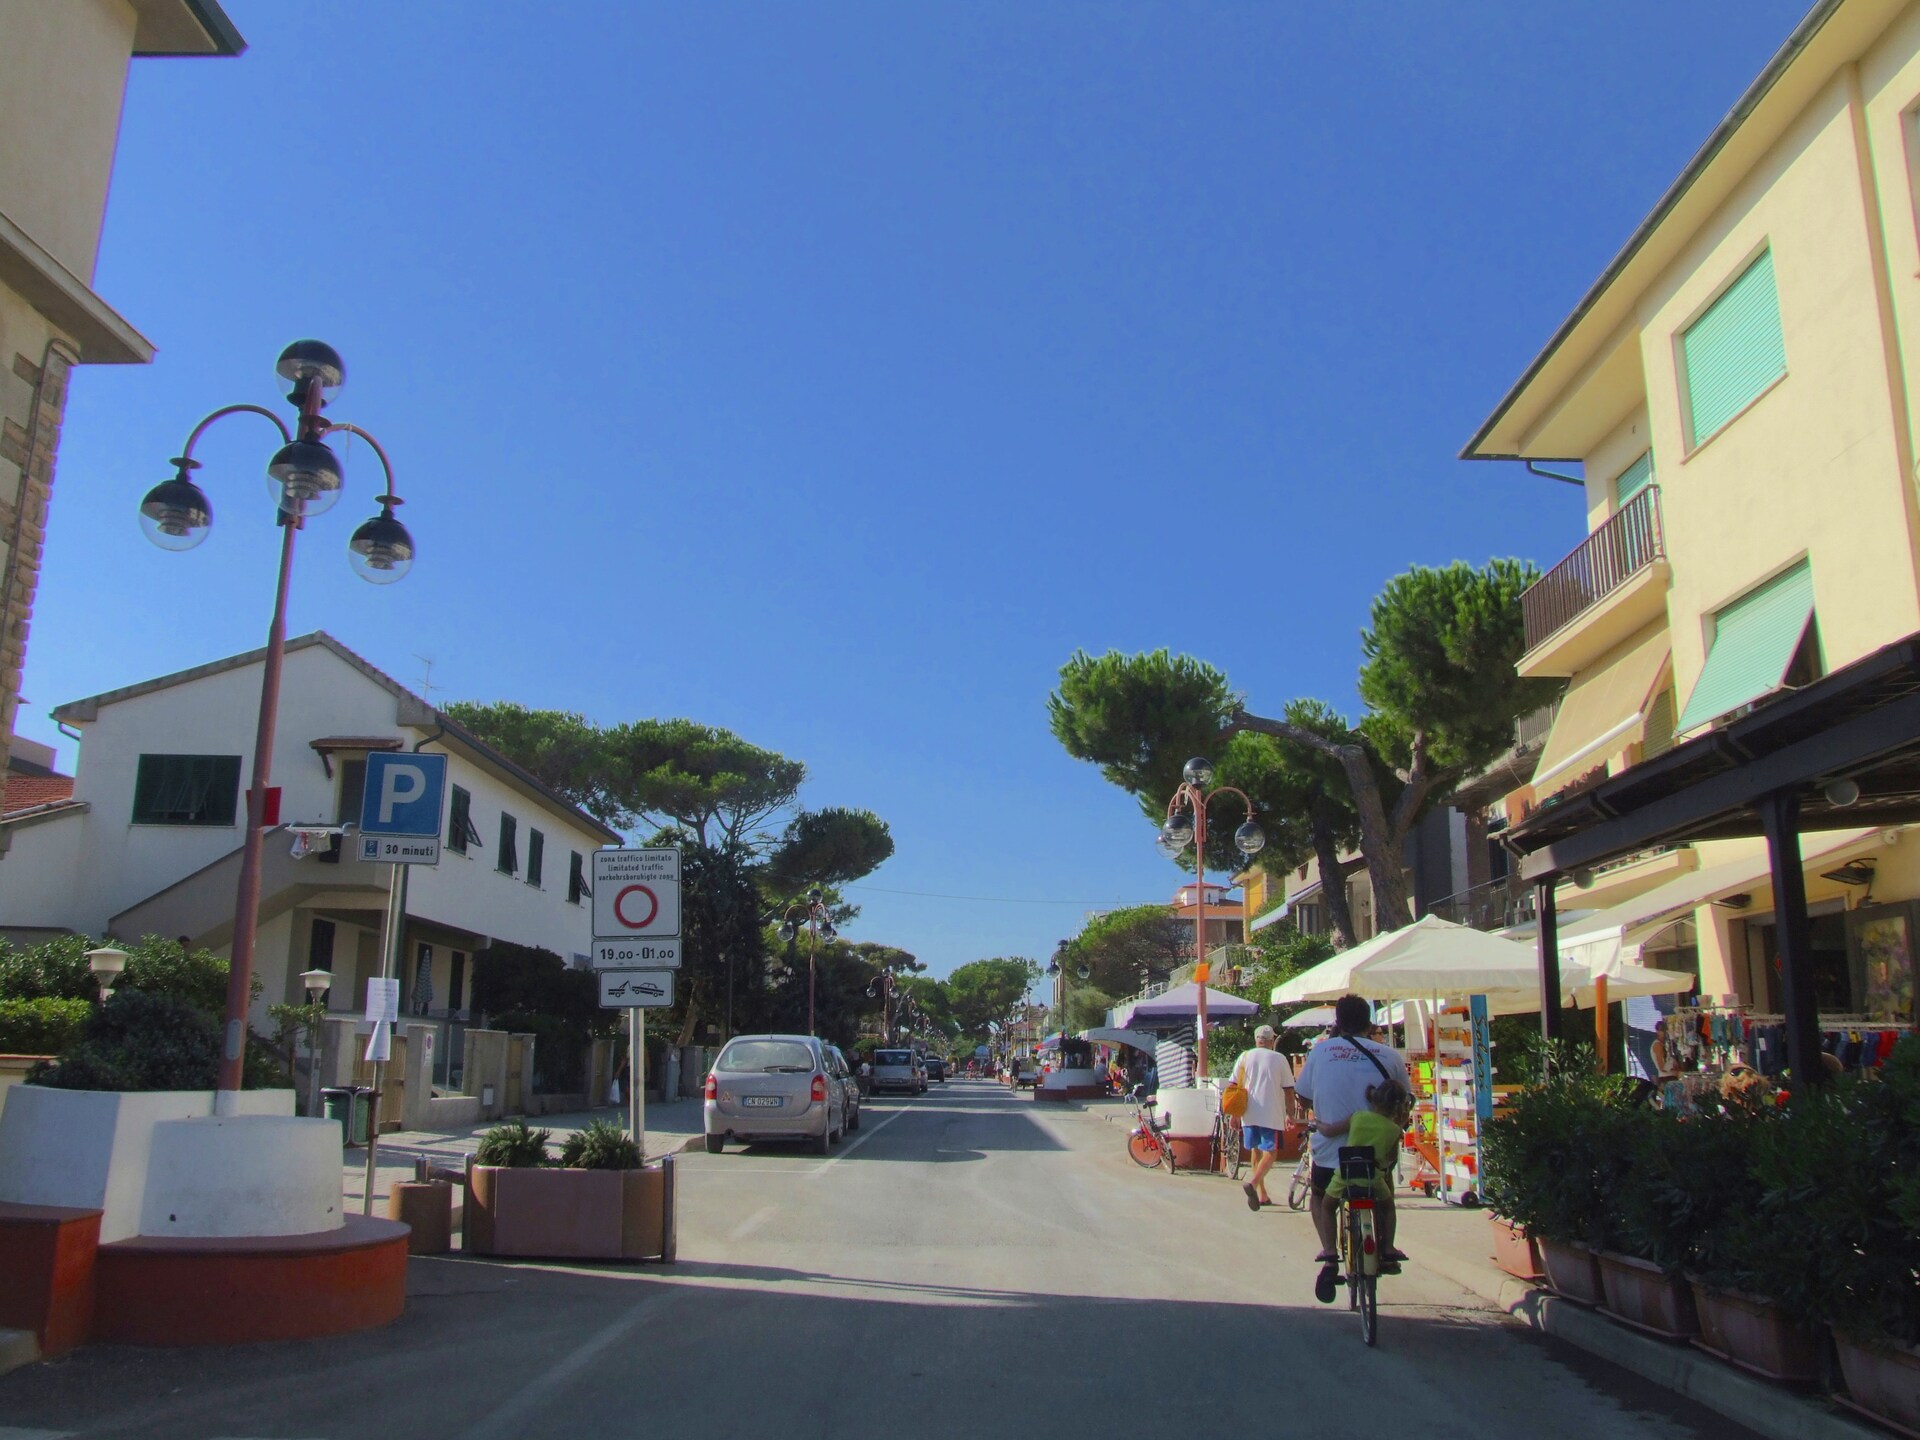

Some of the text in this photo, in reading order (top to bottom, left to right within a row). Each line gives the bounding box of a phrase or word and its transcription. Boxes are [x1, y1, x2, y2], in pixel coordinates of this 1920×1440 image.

[379, 764, 426, 823] P
[385, 844, 434, 856] 30 minuti
[617, 854, 643, 862] traffico
[645, 854, 672, 862] limitato
[641, 863, 664, 871] traffic
